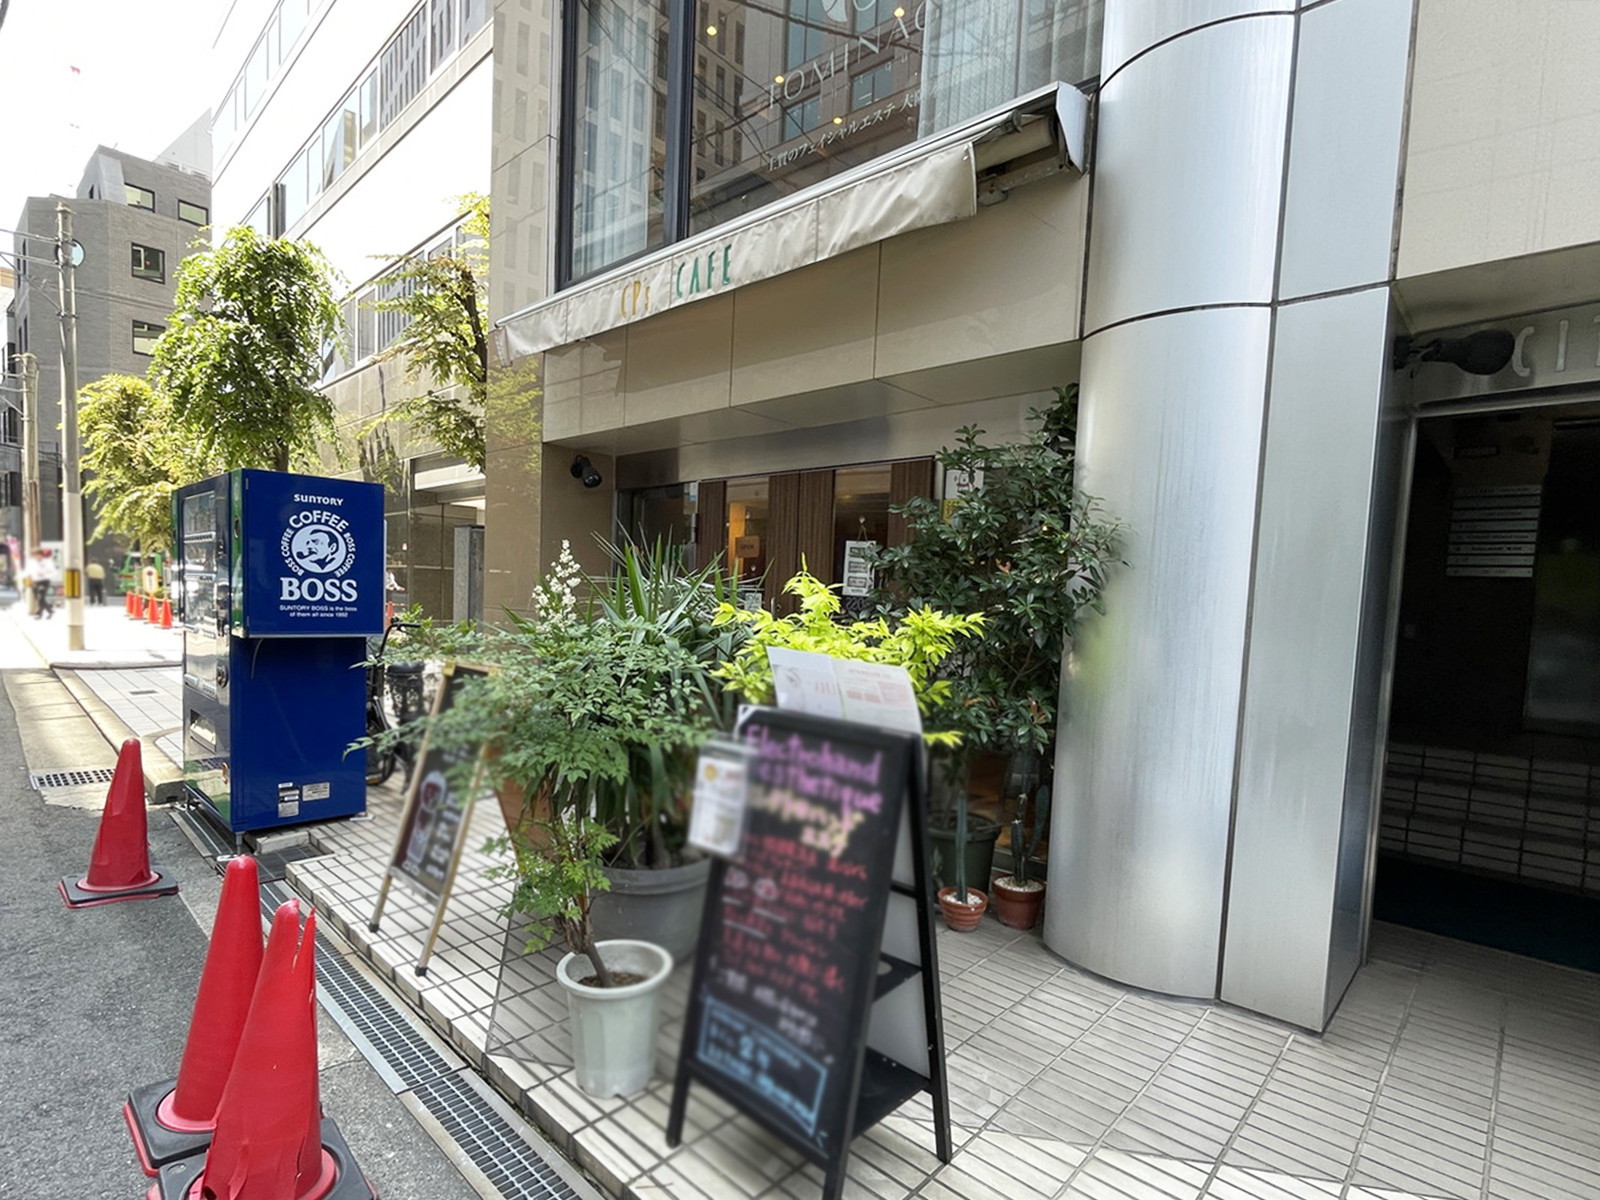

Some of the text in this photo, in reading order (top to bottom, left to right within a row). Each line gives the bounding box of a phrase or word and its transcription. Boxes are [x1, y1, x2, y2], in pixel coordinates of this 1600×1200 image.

[675, 243, 732, 298] CAFE
[293, 493, 344, 506] SUNTORY
[289, 510, 349, 533] COFFEE
[280, 528, 305, 577] BOSS COFFEE
[333, 532, 356, 578] BOSS COFFEE
[279, 577, 358, 602] BOSS
[279, 604, 310, 612] SUNTORY
[311, 604, 329, 612] BOSS
